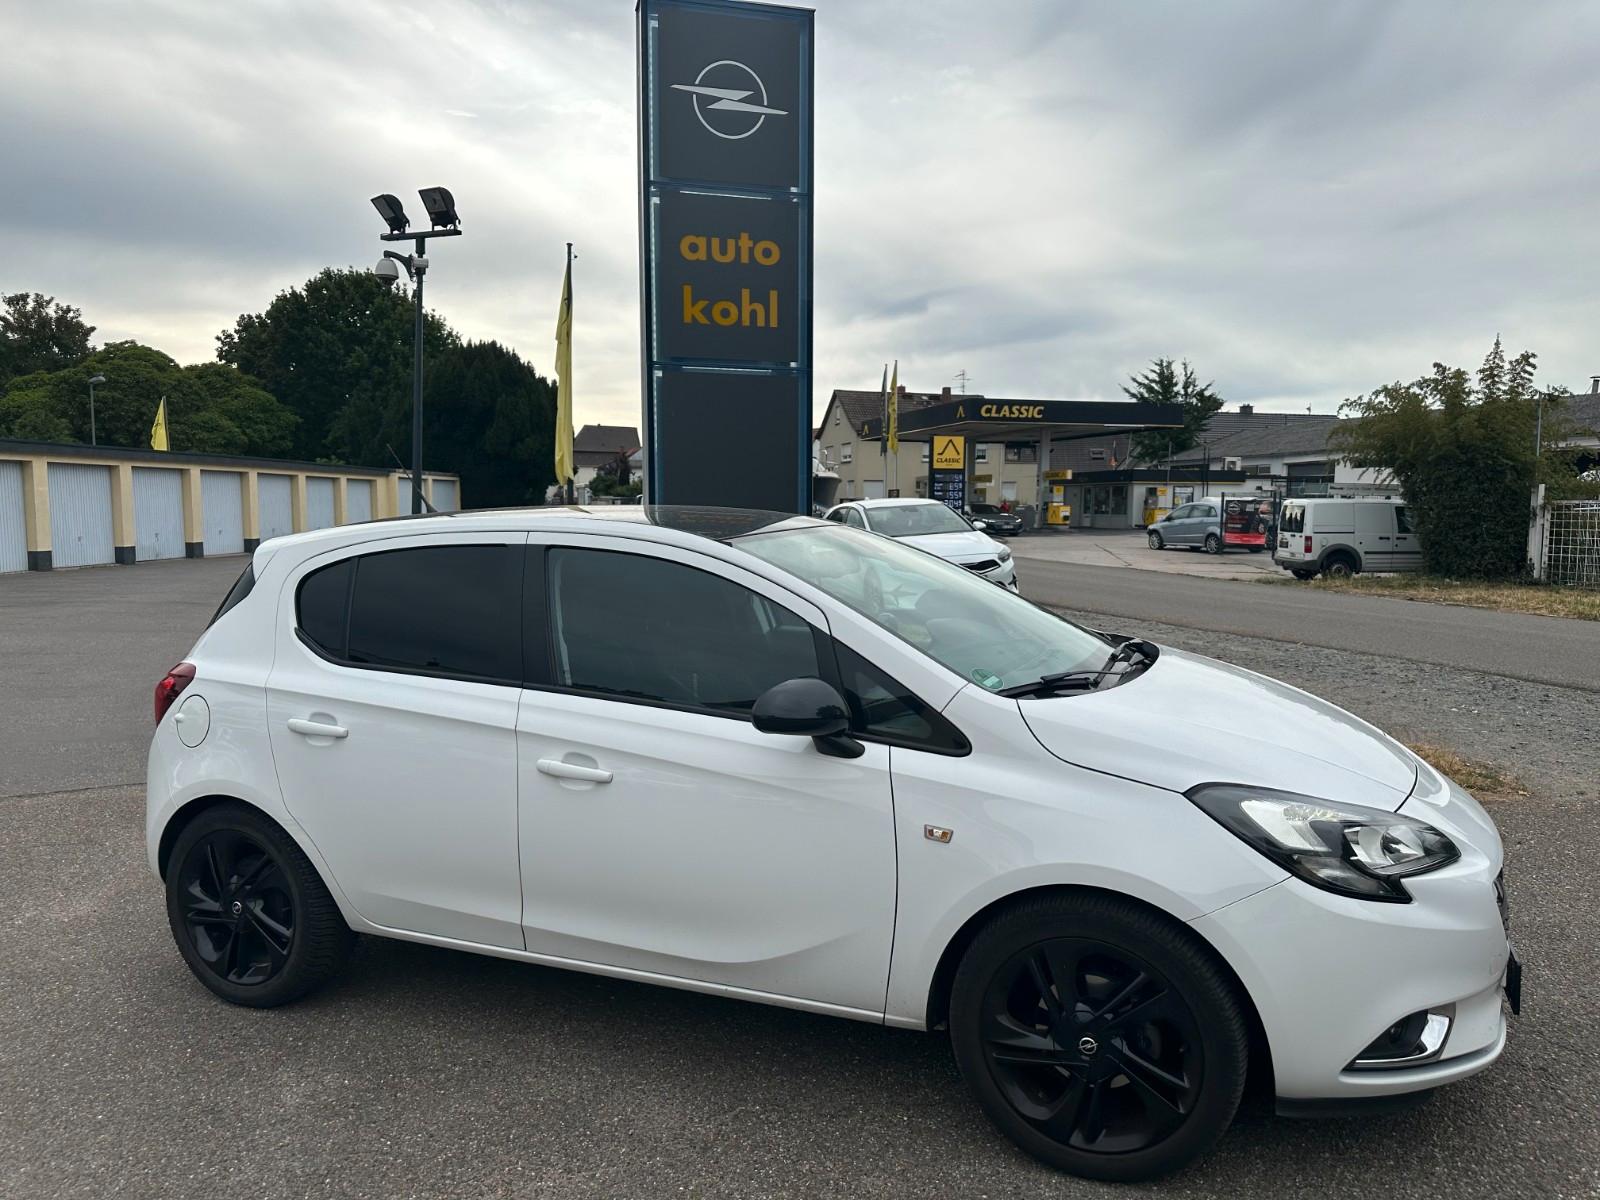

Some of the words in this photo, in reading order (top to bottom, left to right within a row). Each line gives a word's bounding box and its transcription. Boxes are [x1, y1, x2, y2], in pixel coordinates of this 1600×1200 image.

[679, 232, 781, 266] auto
[681, 284, 778, 328] kohl
[980, 404, 1045, 419] CLASSIC
